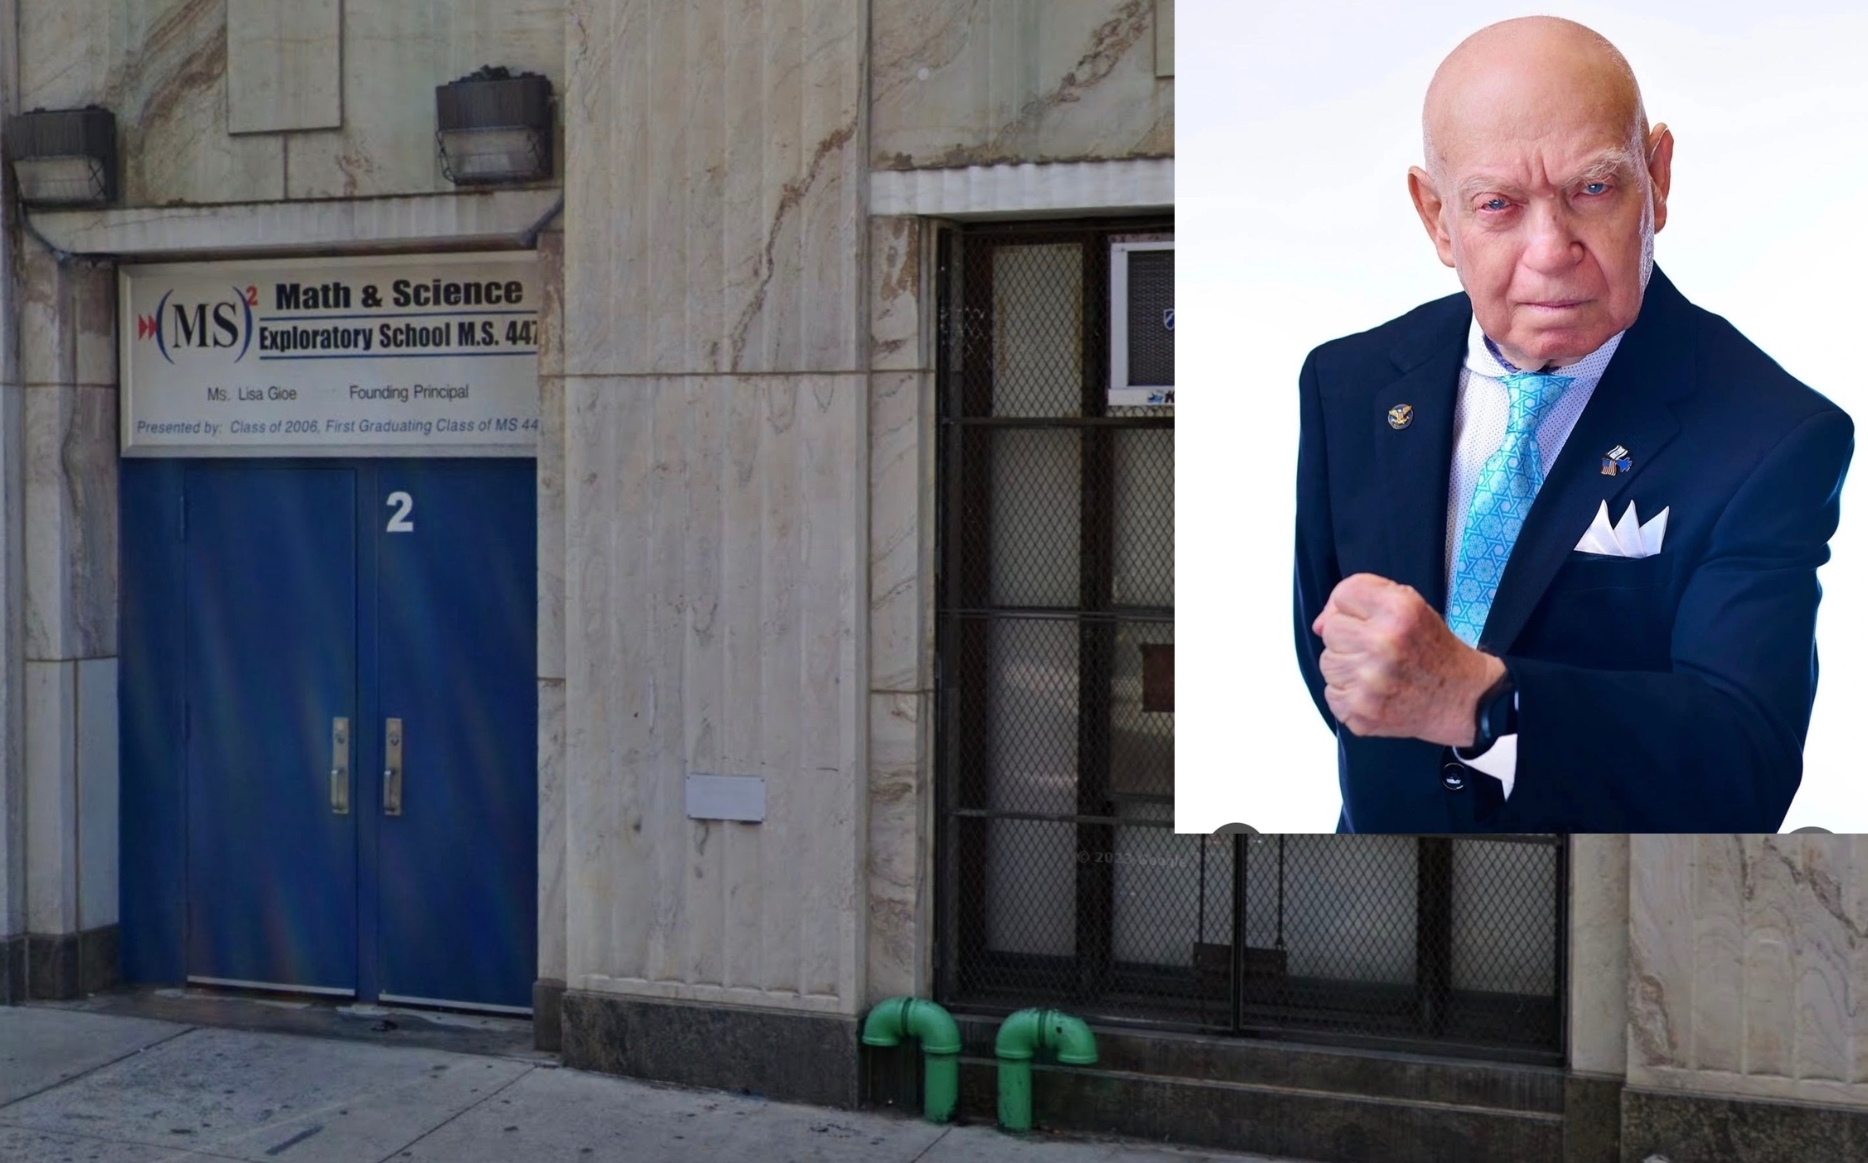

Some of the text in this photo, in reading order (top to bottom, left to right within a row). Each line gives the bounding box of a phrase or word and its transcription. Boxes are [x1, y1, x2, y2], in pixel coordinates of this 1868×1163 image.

[276, 279, 523, 310] Math & Science
[259, 326, 373, 352] Exploratory
[379, 322, 450, 348] School
[458, 321, 499, 347] M.S.
[207, 384, 469, 402] Ms. Lisa Gioe Founding Principal
[137, 418, 538, 436] Presented by: Class of 2006, First Graduating Class of MS 44
[386, 491, 413, 532] 2
